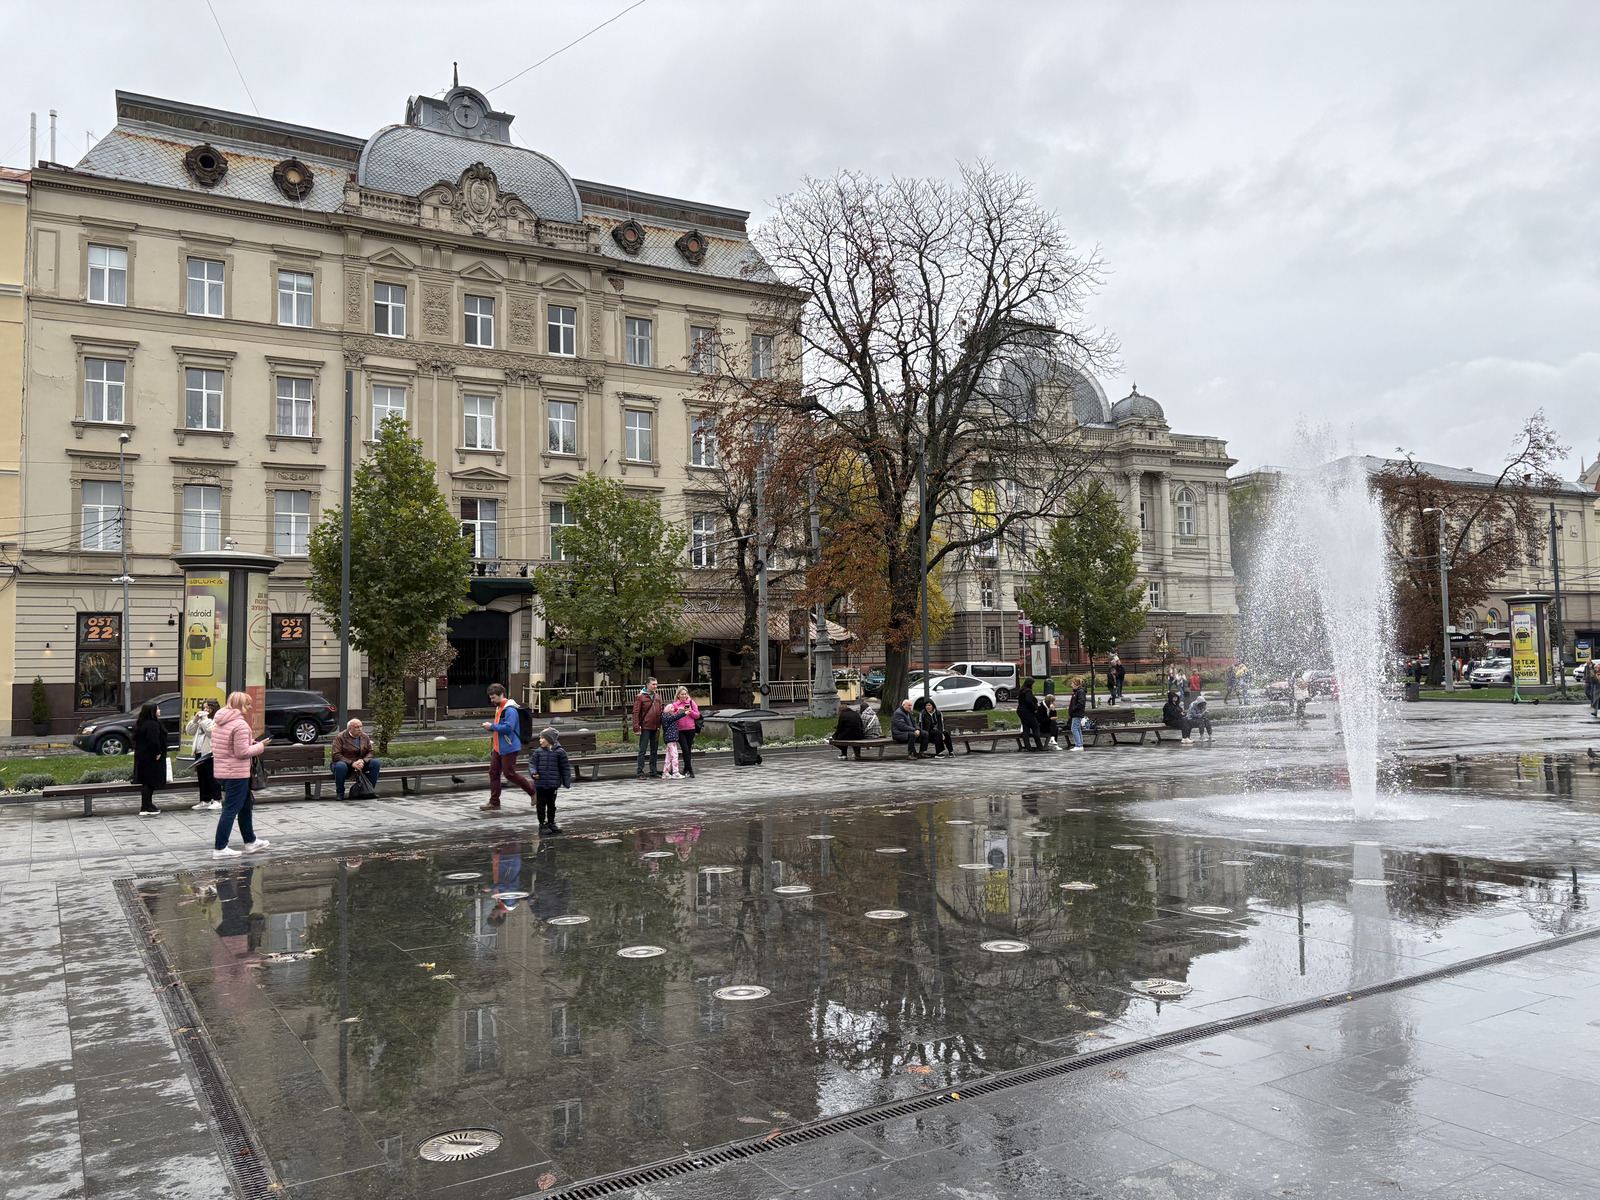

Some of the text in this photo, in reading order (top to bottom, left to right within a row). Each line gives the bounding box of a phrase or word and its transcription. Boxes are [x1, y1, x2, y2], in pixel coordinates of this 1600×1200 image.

[188, 609, 212, 617] Android
[87, 617, 113, 626] OST
[281, 618, 303, 626] OST
[87, 626, 114, 639] 22
[281, 626, 303, 638] 22
